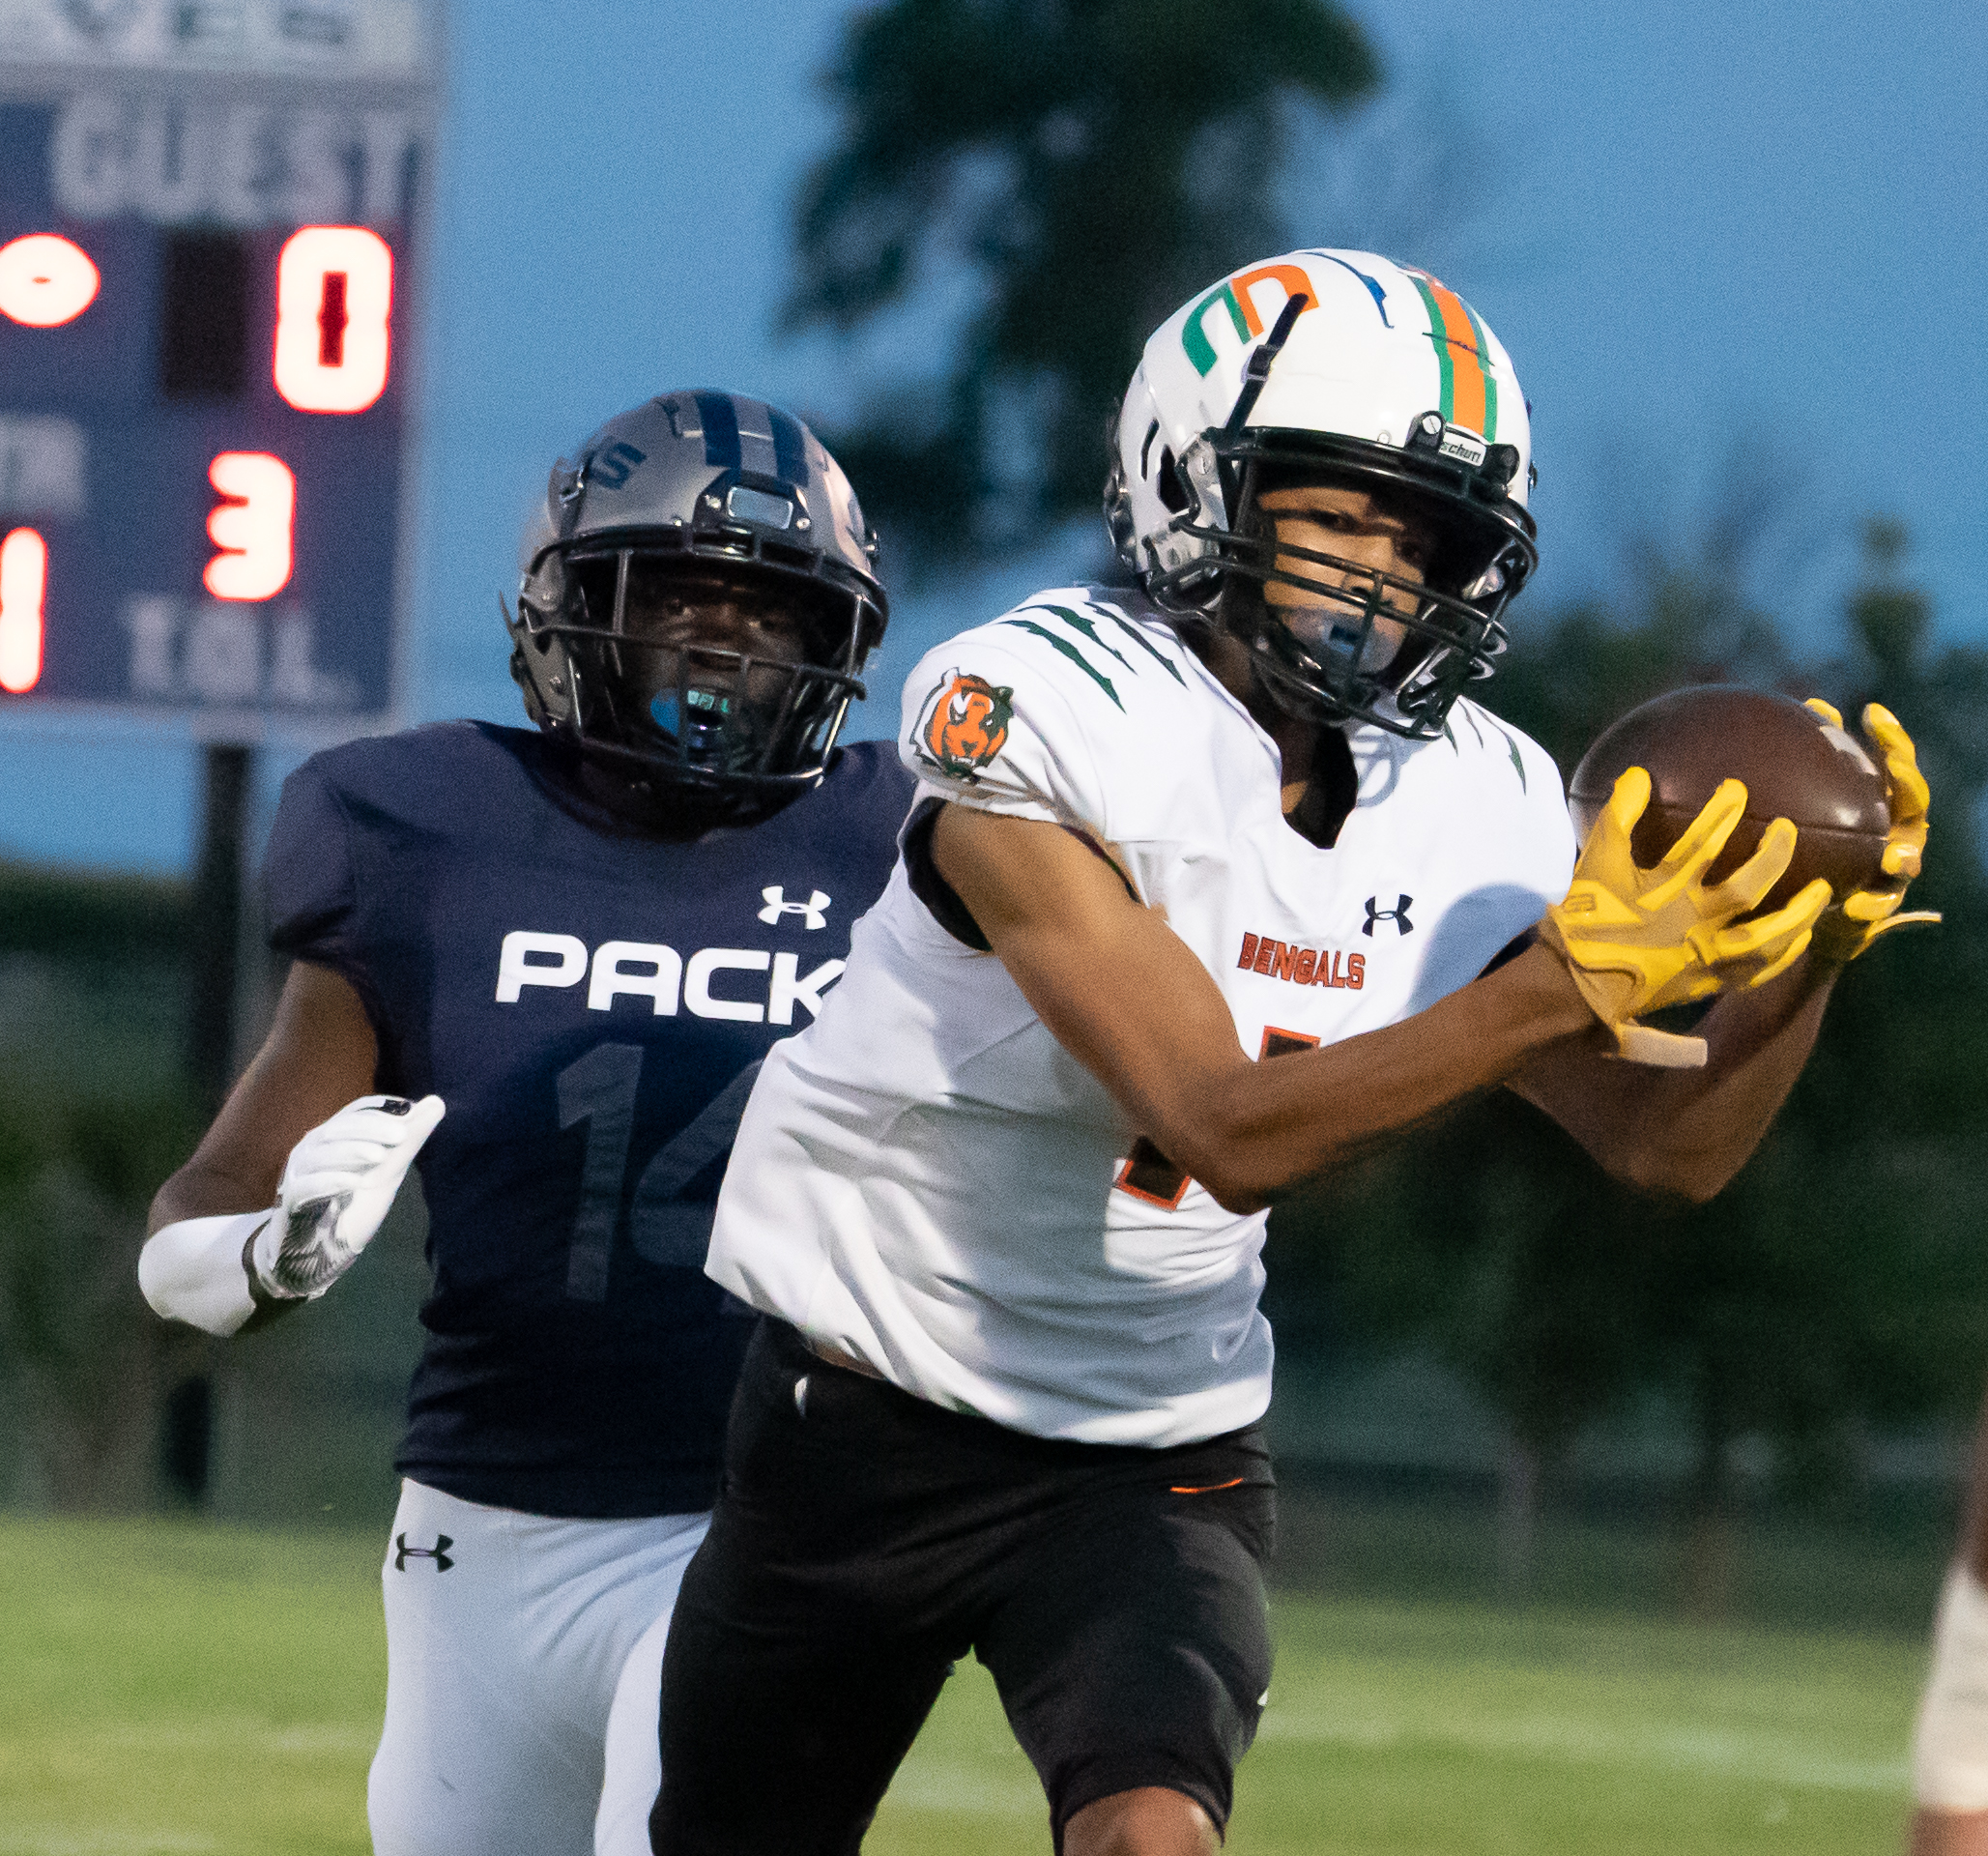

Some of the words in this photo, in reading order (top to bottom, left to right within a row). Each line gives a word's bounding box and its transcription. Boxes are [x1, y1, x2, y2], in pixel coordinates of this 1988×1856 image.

[274, 224, 394, 415] 0
[203, 450, 297, 602] 3
[495, 930, 847, 1026] PACK
[1236, 931, 1366, 991] BENGALS
